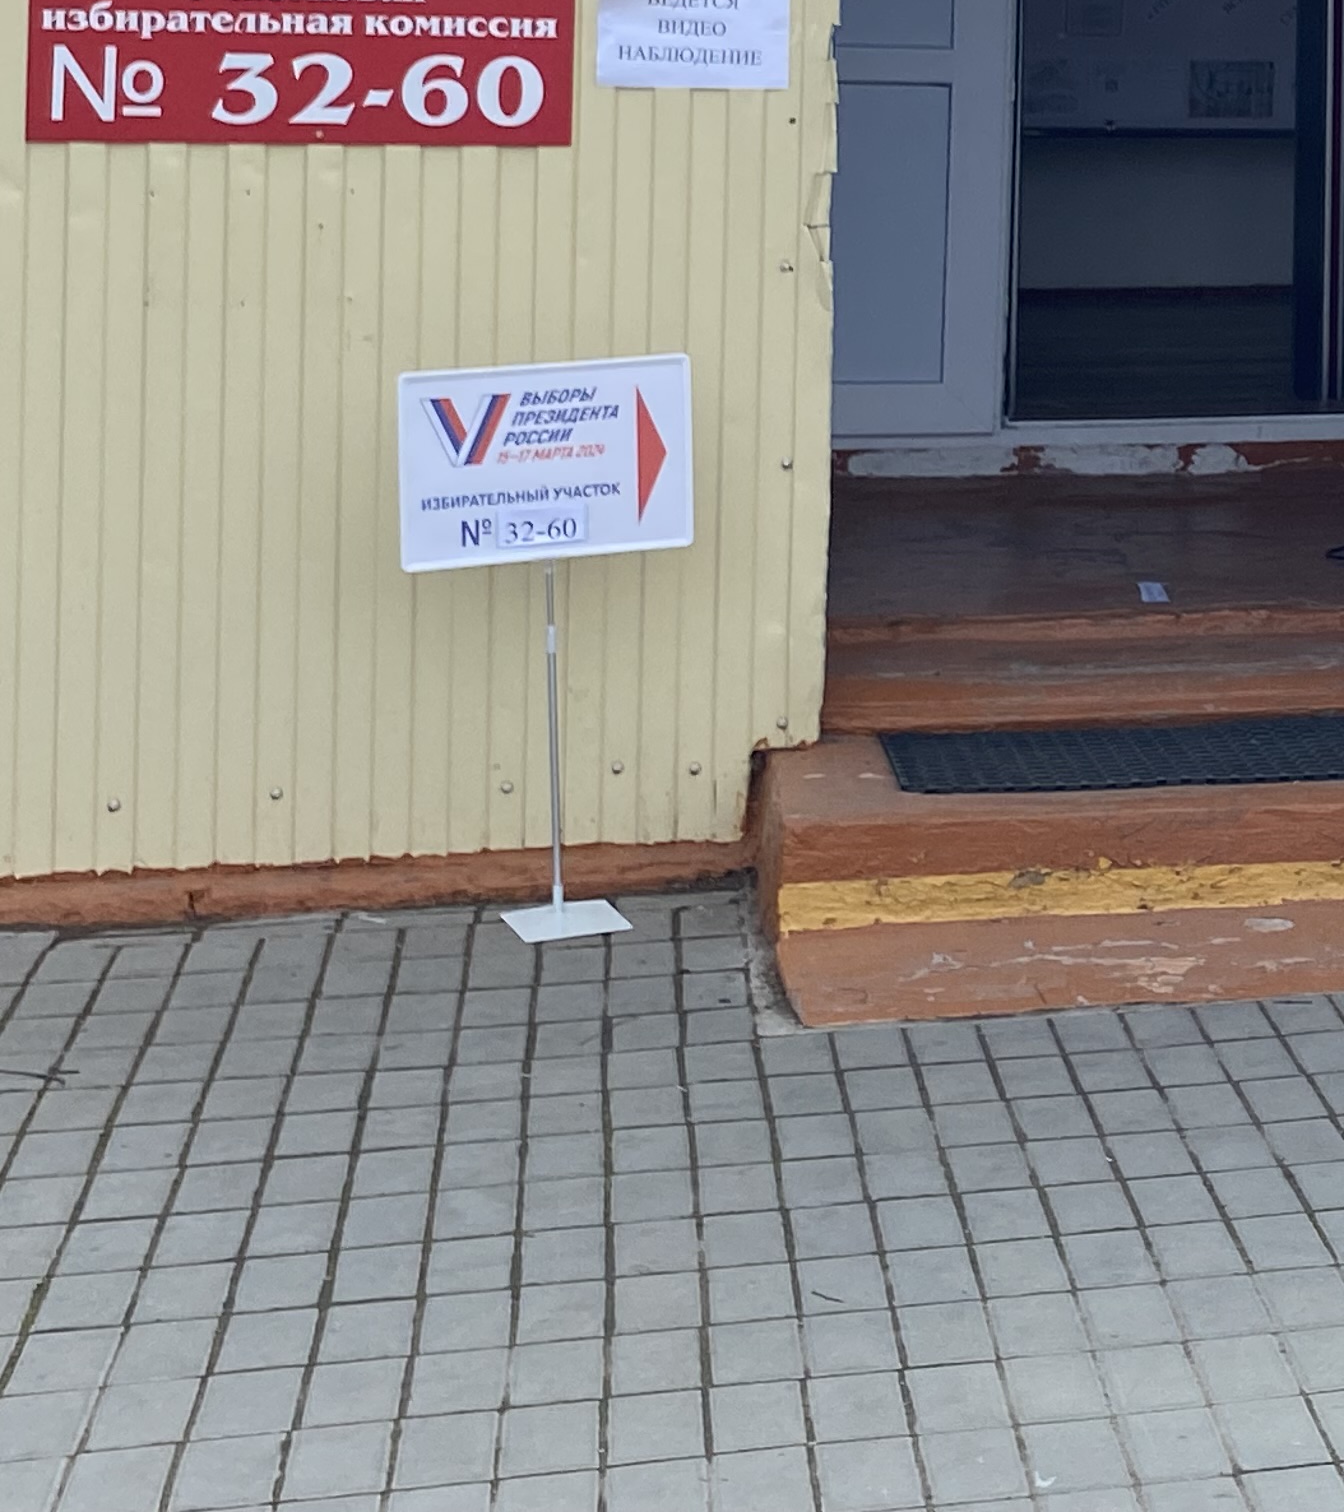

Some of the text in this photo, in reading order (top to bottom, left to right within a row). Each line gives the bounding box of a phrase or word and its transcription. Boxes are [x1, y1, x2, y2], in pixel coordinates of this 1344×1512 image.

[42, 0, 558, 40] избирательная комиссия
[658, 19, 727, 37] ВИДЕО
[618, 45, 762, 66] НАБЛЮДЕНИЕ
[50, 43, 545, 128] № 32-60
[520, 387, 597, 406] ВЫБОРЫ
[511, 405, 620, 427] ПРЕЗИДЕНТА
[503, 428, 574, 446] РОССИИ
[532, 446, 574, 462] МАРТА
[421, 483, 621, 511] ИЗБИРАТЕЛЬНЫЙ УЧАСТОК
[505, 518, 577, 544] 32-60
